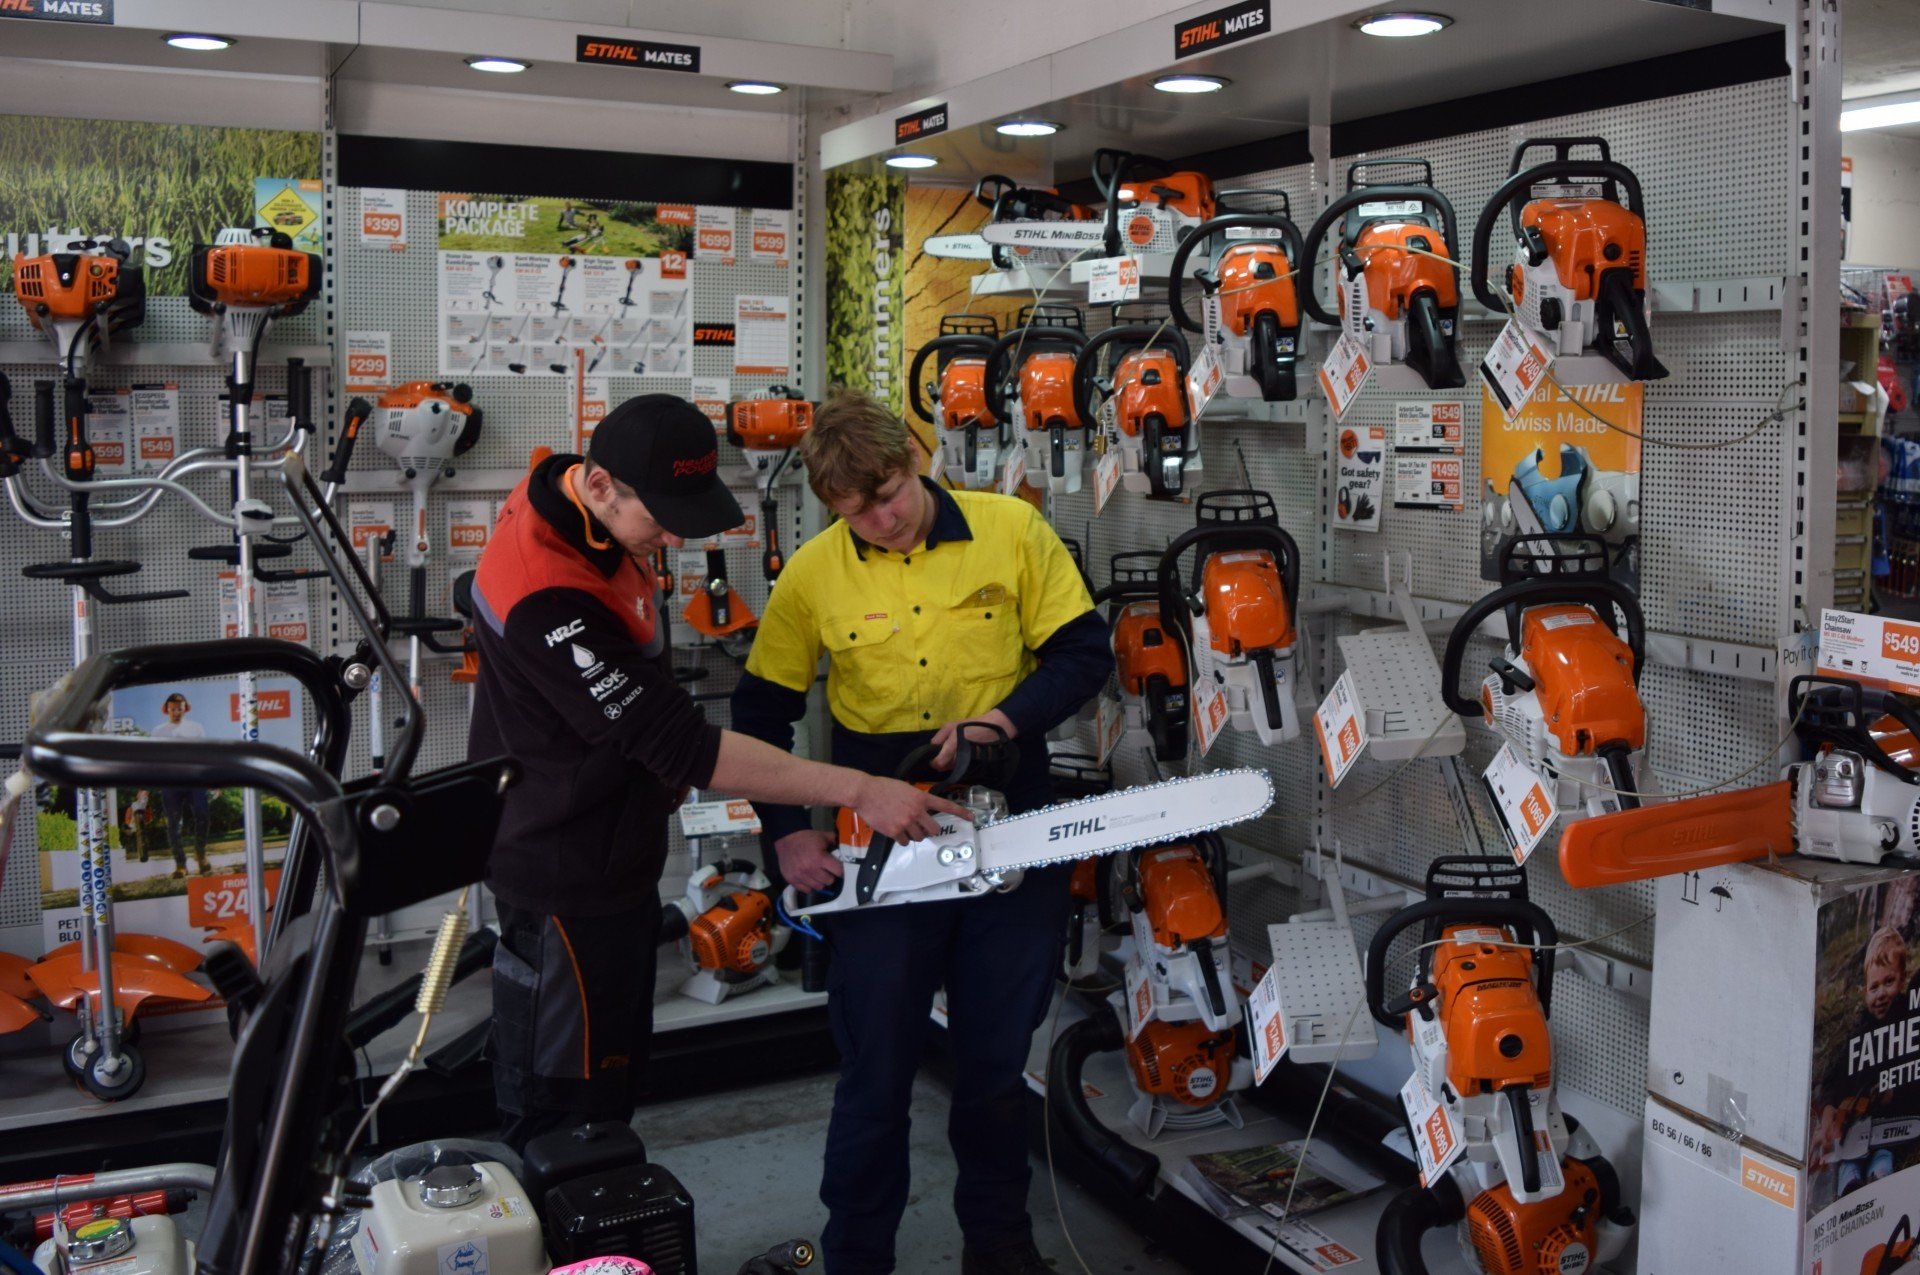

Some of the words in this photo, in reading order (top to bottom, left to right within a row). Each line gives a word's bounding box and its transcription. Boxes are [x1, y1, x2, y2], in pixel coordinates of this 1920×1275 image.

[43, 1, 104, 16] MATES
[1180, 20, 1221, 49] STIHL
[1225, 8, 1264, 35] MATES
[584, 43, 638, 61] STIHL
[645, 51, 692, 66] MATES
[898, 120, 921, 138] STIHL
[922, 112, 945, 131] MATES
[445, 199, 539, 222] KOMPLETE
[659, 209, 691, 221] STIHL
[365, 217, 400, 232] $399
[445, 217, 526, 238] PACKAGE
[1014, 229, 1048, 239] STIHL
[700, 234, 730, 247] $699
[755, 235, 784, 249] $599
[662, 253, 683, 270] 12
[694, 328, 736, 341] STIHL
[351, 359, 385, 373] $299
[1522, 353, 1540, 382] $249
[1556, 383, 1626, 403] STIHL
[1433, 406, 1460, 420] $1549
[1503, 412, 1551, 432] Swiss
[1557, 412, 1608, 434] Made
[142, 440, 172, 452] $549
[1341, 467, 1355, 476] Got
[1356, 467, 1381, 481] safety
[1432, 463, 1459, 477] $1499
[1348, 480, 1372, 490] gear?
[453, 529, 485, 543] $199
[1824, 623, 1852, 634] Chainsaw
[1825, 612, 1855, 625] Easy2Start
[545, 618, 585, 648] HRC
[1885, 631, 1919, 655] $549
[1783, 648, 1799, 667] Pay
[1801, 645, 1808, 659] it
[589, 668, 625, 698] NGK
[621, 685, 644, 706] CALTEX
[1527, 791, 1545, 827] $1,069
[1048, 815, 1107, 842] STIHL
[1672, 822, 1718, 845] STIHL
[58, 918, 80, 931] PET
[59, 931, 82, 944] BLO
[1909, 988, 1920, 1011] M
[1269, 1017, 1280, 1054] $1,749
[1848, 1015, 1920, 1076] FATHE
[1190, 1075, 1214, 1084] STIHL
[1878, 1059, 1920, 1093] BETTE
[1431, 1111, 1448, 1156] $2,099
[1652, 1118, 1665, 1134] BG
[1666, 1124, 1678, 1140] 56
[1683, 1133, 1695, 1149] 66
[1701, 1142, 1712, 1158] 86
[1882, 1125, 1910, 1140] STIHL
[1746, 1168, 1790, 1197] STIHL
[1814, 1223, 1825, 1240] MS
[1826, 1215, 1837, 1232] 170
[1814, 1230, 1839, 1257] PETROL
[1840, 1205, 1885, 1238] CHAINSAW
[1325, 1245, 1350, 1262] $499
[1561, 1252, 1586, 1265] STIHL
